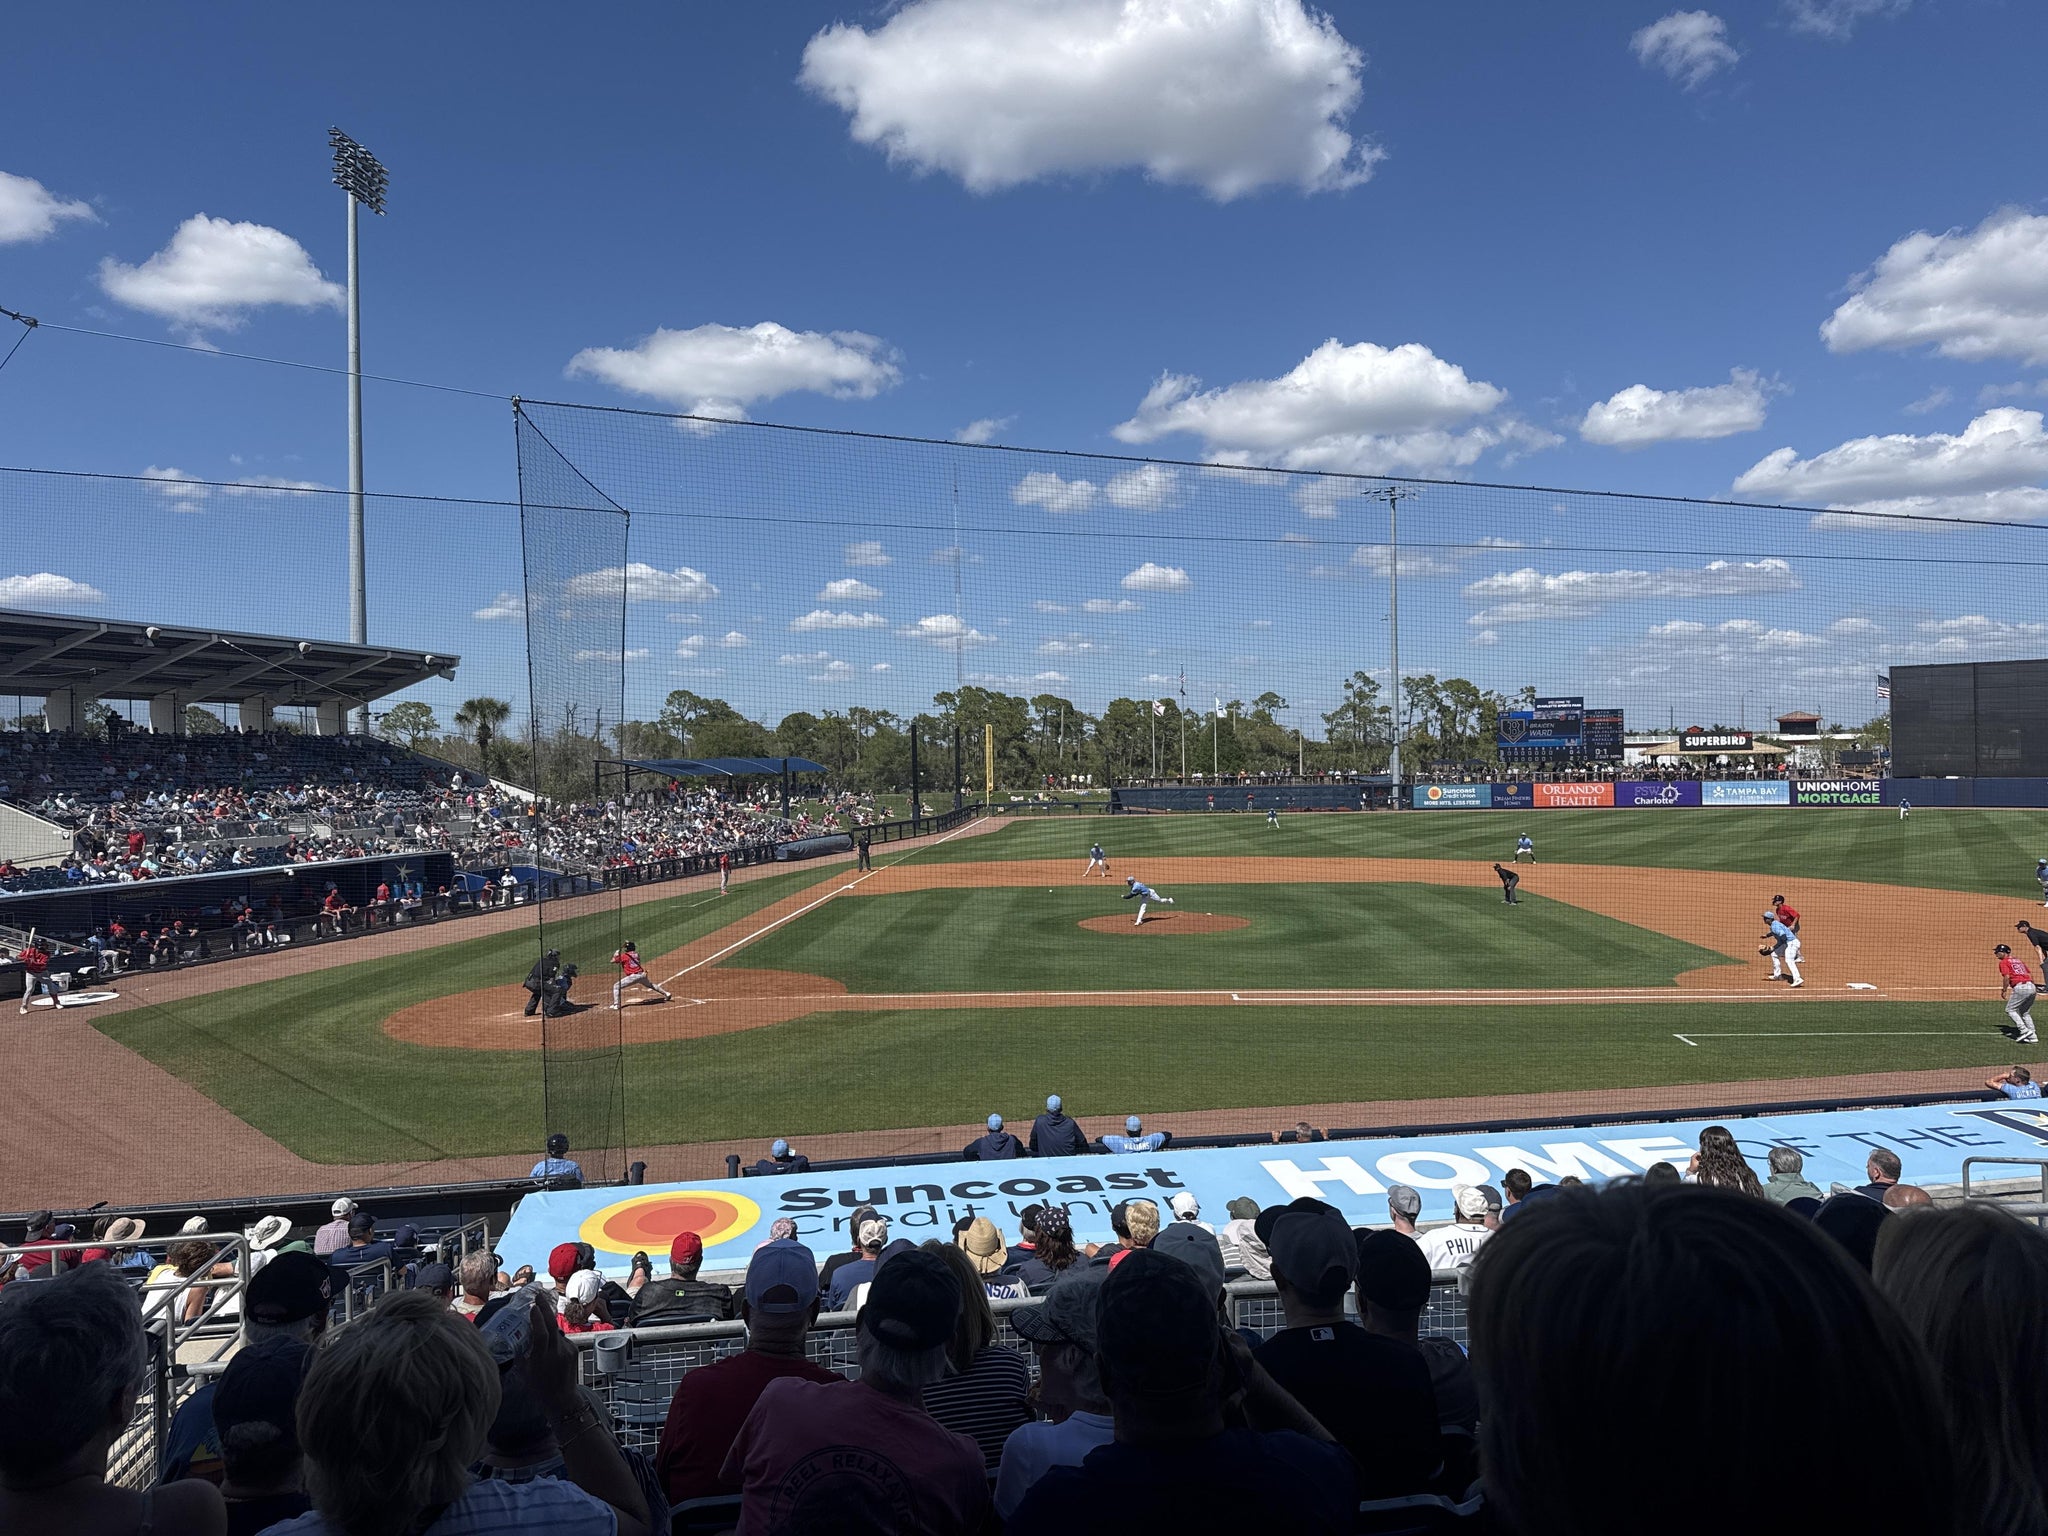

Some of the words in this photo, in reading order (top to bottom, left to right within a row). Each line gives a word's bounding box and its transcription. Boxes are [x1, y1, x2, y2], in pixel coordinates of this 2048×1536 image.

[1685, 736, 1746, 746] SUPERBIRD
[1542, 784, 1605, 795] ORLANDO
[1760, 787, 1778, 795] BAY
[1550, 796, 1599, 806] HEALTH
[1634, 796, 1674, 805] Charlotte
[1797, 793, 1881, 804] MORTGAGE
[1123, 1142, 1150, 1151] WILLIAMS
[1259, 1135, 1699, 1200] HOME
[1735, 1137, 1821, 1160] OF
[1826, 1126, 2004, 1151] THE
[780, 1167, 1185, 1212] Suncoast
[787, 1203, 986, 1235] Crdit
[1007, 1194, 1202, 1222] Uni
[783, 1461, 822, 1501] REEL
[832, 1454, 912, 1536] RELAXATIO
